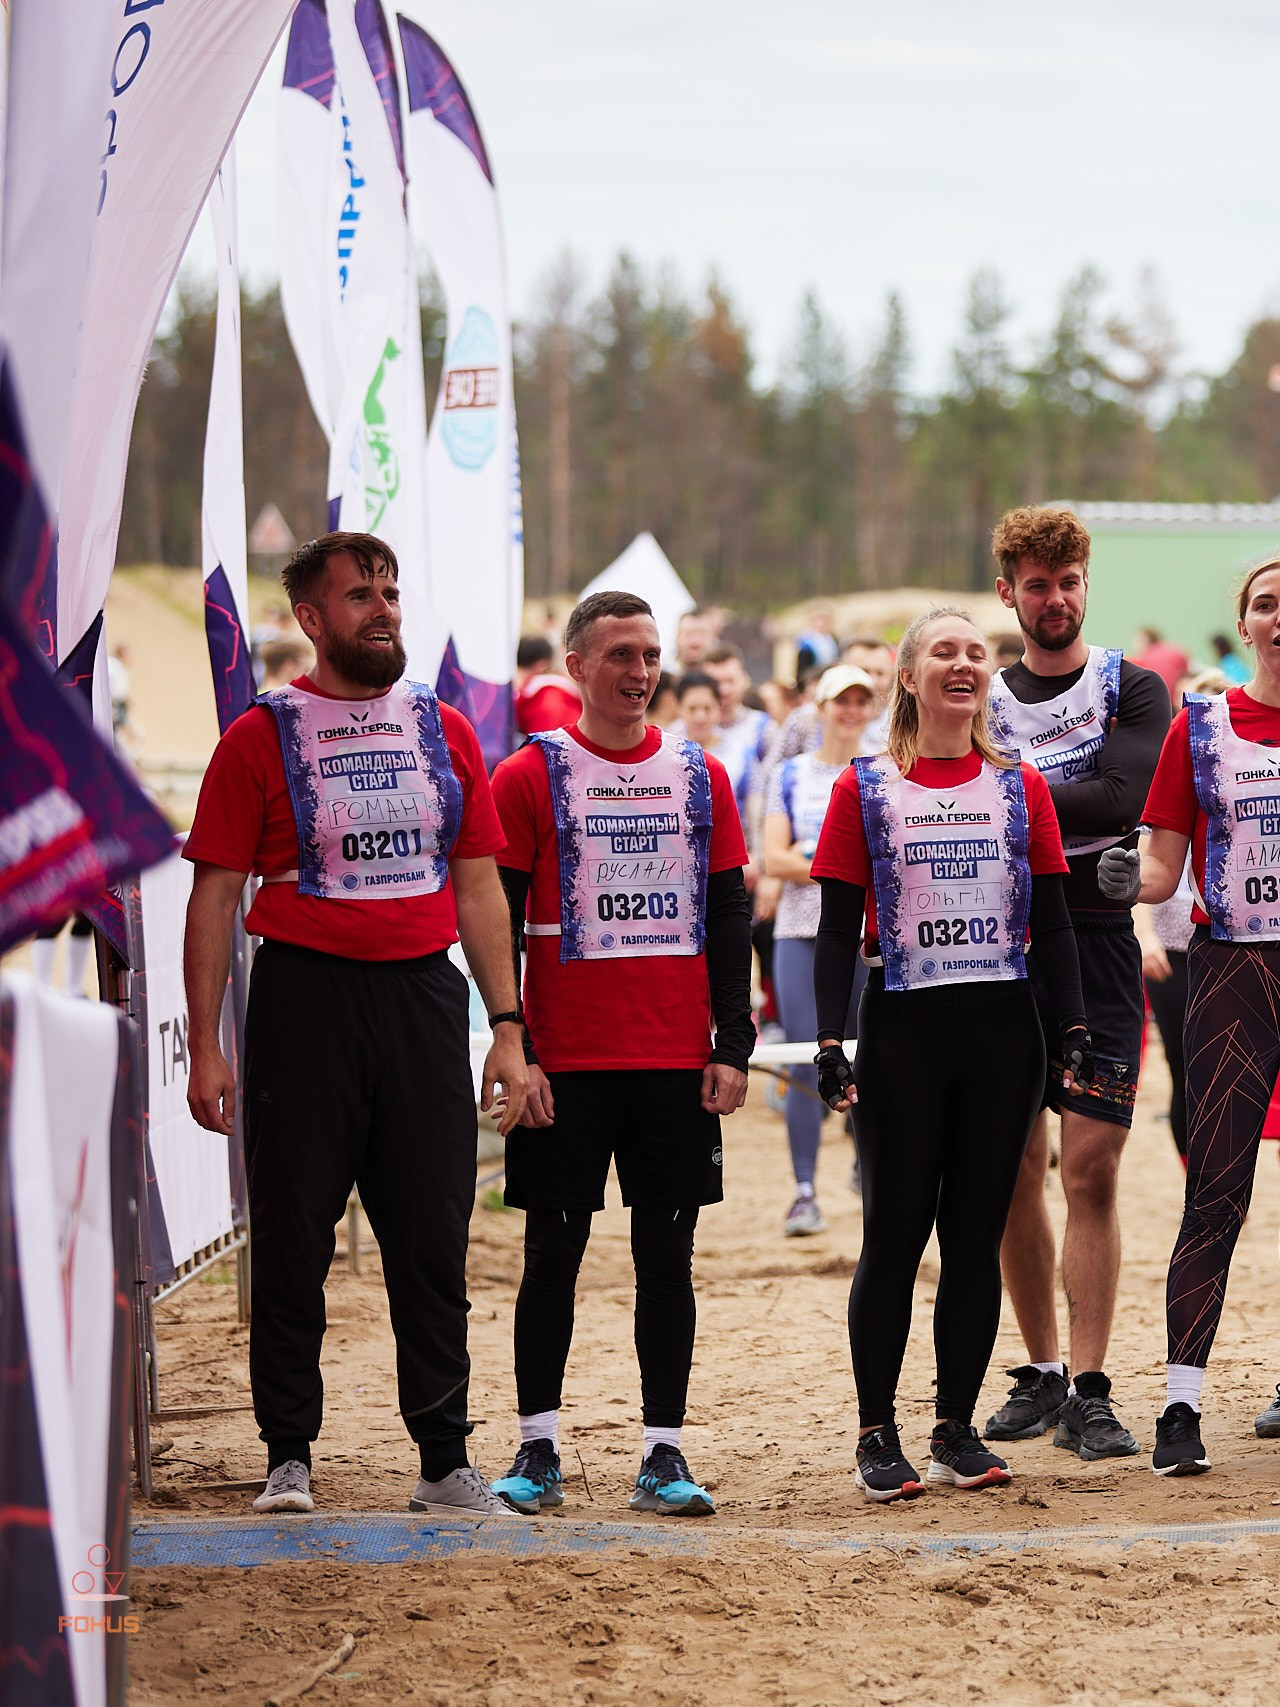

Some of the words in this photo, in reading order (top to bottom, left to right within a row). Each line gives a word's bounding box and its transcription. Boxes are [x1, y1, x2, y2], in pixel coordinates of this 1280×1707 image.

[317, 726, 359, 740] ГОНКА
[361, 722, 403, 735] ГЕРОЕВ
[1029, 725, 1064, 747] ГОНКА
[1064, 706, 1095, 730] ГЕРОЕ
[321, 751, 416, 775] КОМАНДНЫЙ
[1064, 755, 1096, 778] СТАРТ
[352, 772, 395, 790] СТАРТ
[1236, 769, 1274, 782] ГОНКА
[586, 787, 625, 797] ГОНКА
[627, 786, 672, 797] ГЕРОЕВ
[331, 797, 419, 825] РОМАН
[905, 814, 944, 825] ГОНКА
[947, 813, 991, 823] ГЕРОЕВ
[587, 812, 679, 835] КОМАНДНЫЙ
[342, 828, 422, 862] 03201
[613, 835, 655, 851] СТАРТ
[906, 838, 998, 863] КОМАНДНЫЙ
[365, 871, 426, 886] ГАЗПРОМБАНК
[597, 860, 677, 883] РУСЛАН
[934, 861, 975, 878] СТАРТ
[597, 892, 679, 921] 03203
[917, 887, 985, 910] ОЛЬГА
[621, 935, 680, 945] ГАЗПРОМБАНК
[918, 917, 999, 949] 03202
[942, 959, 1000, 971] ГАЗПРОМБАНК
[159, 1013, 188, 1087] ТА
